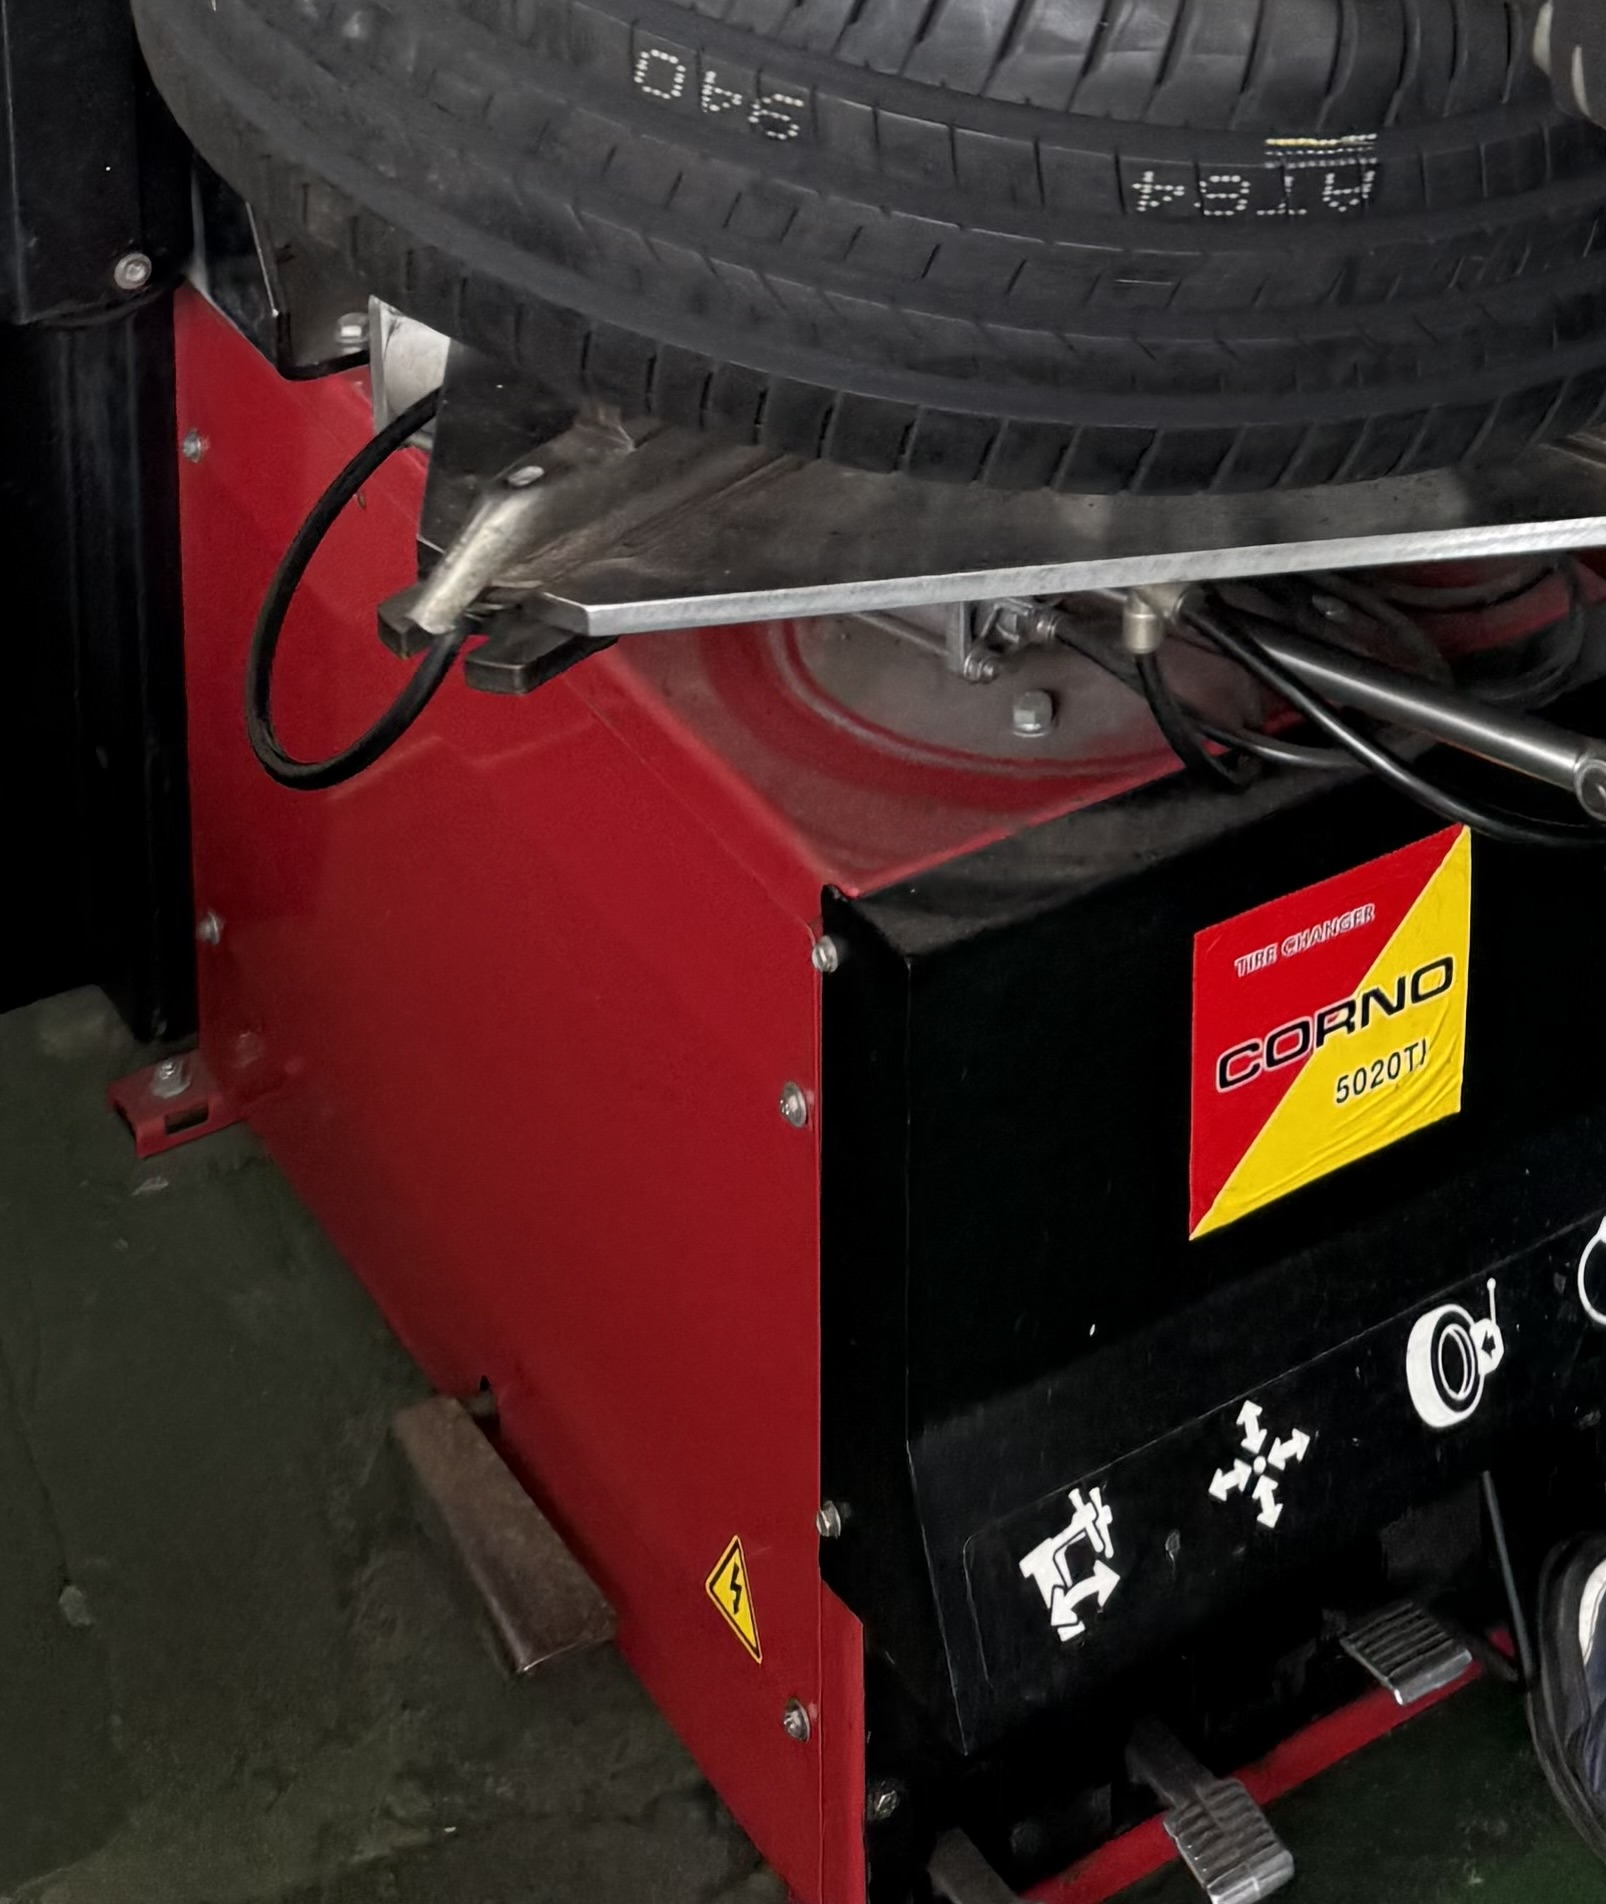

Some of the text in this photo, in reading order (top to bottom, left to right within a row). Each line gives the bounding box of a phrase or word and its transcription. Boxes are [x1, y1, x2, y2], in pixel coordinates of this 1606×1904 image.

[1234, 902, 1376, 978] TIRE CHANGER
[1216, 956, 1455, 1091] CORNO
